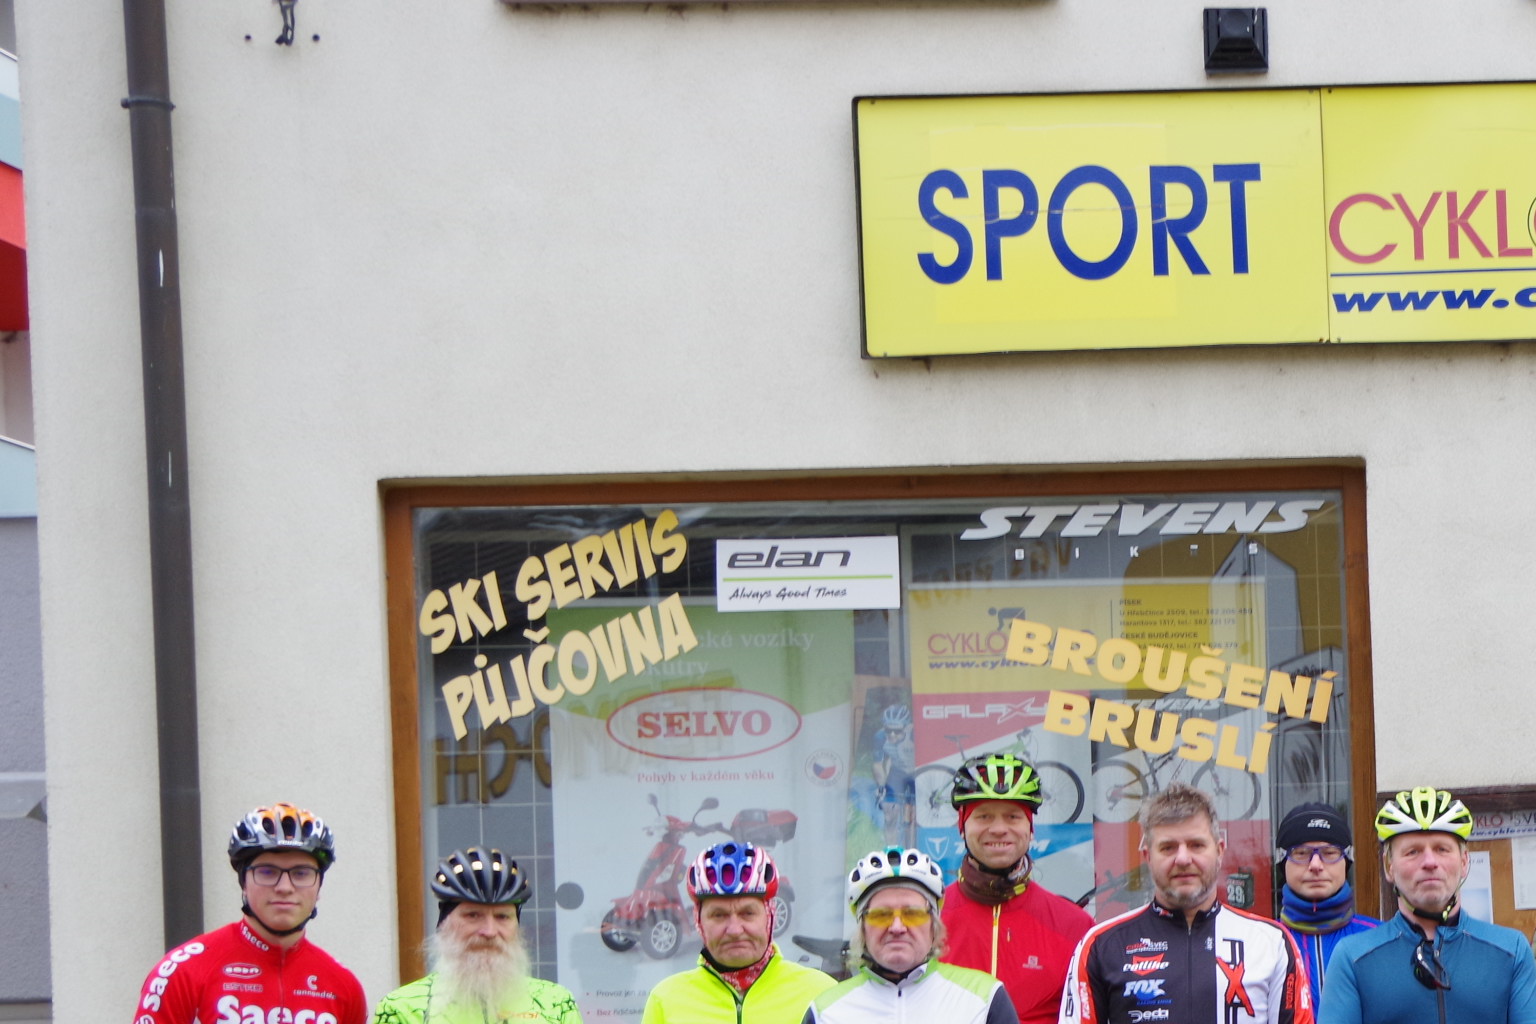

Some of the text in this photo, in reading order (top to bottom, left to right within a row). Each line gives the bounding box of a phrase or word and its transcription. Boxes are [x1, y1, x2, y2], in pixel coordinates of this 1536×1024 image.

[917, 163, 1262, 285] SPORT
[960, 500, 1325, 540] STEVENS
[418, 509, 688, 655] SKI SERVIS
[727, 545, 851, 569] elan
[729, 587, 772, 603] Always
[775, 585, 812, 602] Good
[441, 592, 698, 742] PŮJČOVNA
[1005, 617, 1338, 725] BROUŠENÍ
[637, 710, 773, 739] SELVO
[1043, 690, 1279, 775] BRUSLÍ
[1123, 978, 1168, 997] FOX
